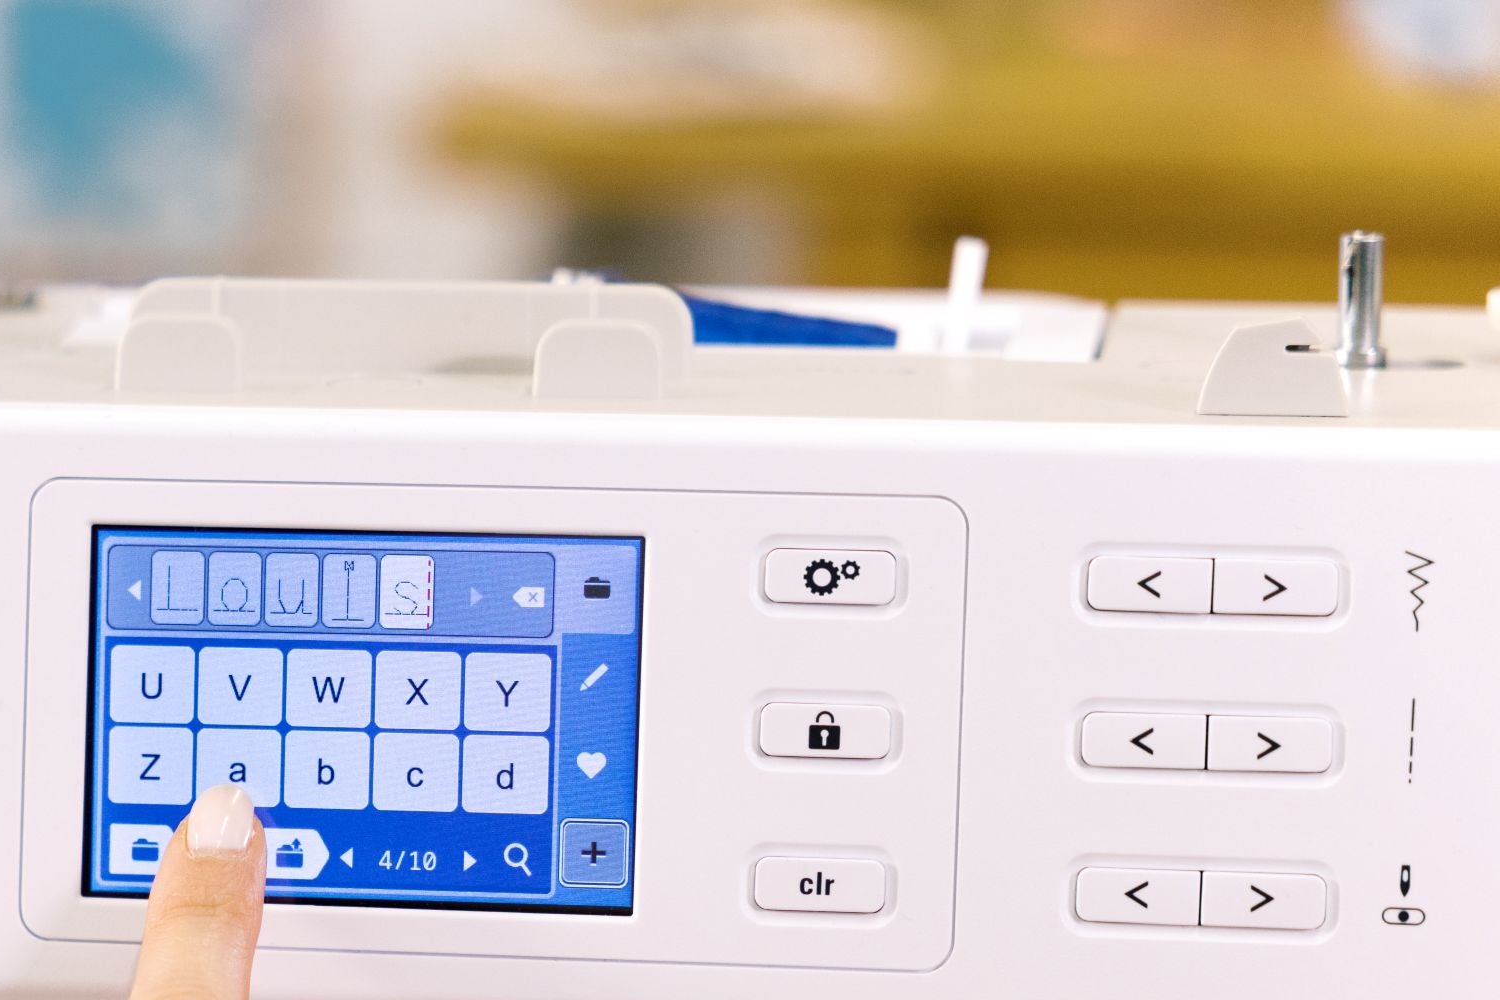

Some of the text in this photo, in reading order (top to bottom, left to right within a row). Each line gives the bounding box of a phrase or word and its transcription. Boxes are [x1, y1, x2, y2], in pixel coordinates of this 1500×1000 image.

[141, 672, 520, 708] U V W X Y
[139, 753, 514, 790] Z a b c d
[378, 850, 437, 871] 4/10
[799, 871, 835, 896] clr
